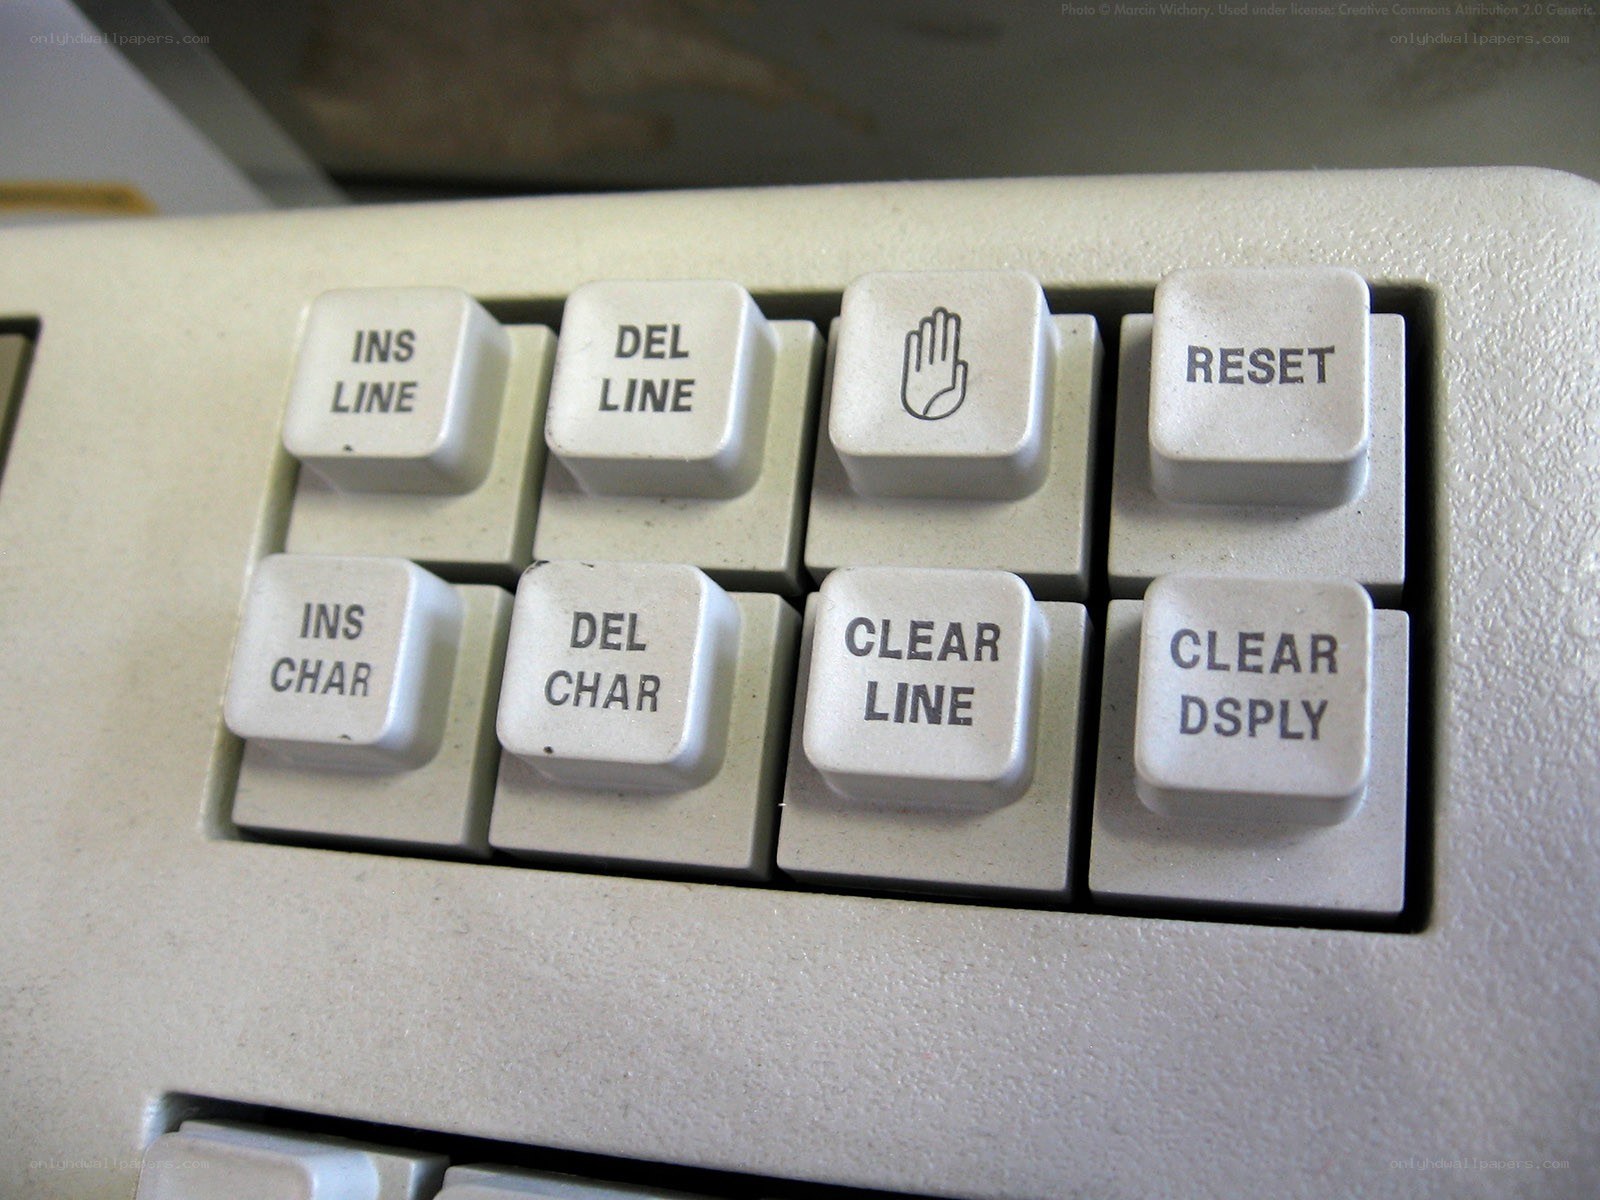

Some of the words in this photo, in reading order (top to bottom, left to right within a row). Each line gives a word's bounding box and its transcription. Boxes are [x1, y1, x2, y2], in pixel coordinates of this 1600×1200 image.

[352, 329, 417, 364] INS
[615, 324, 690, 360] DEL
[1186, 345, 1335, 385] RESET
[331, 380, 419, 414] LINE
[599, 378, 696, 414] LINE
[299, 602, 366, 641] INS
[569, 610, 647, 653] DEL
[844, 616, 1001, 664] CLEAR
[1169, 628, 1339, 676] CLEAR
[269, 656, 372, 698] CHAR
[543, 669, 662, 713] CHAR
[863, 680, 976, 727] LINE
[1178, 694, 1329, 742] DSPLY
